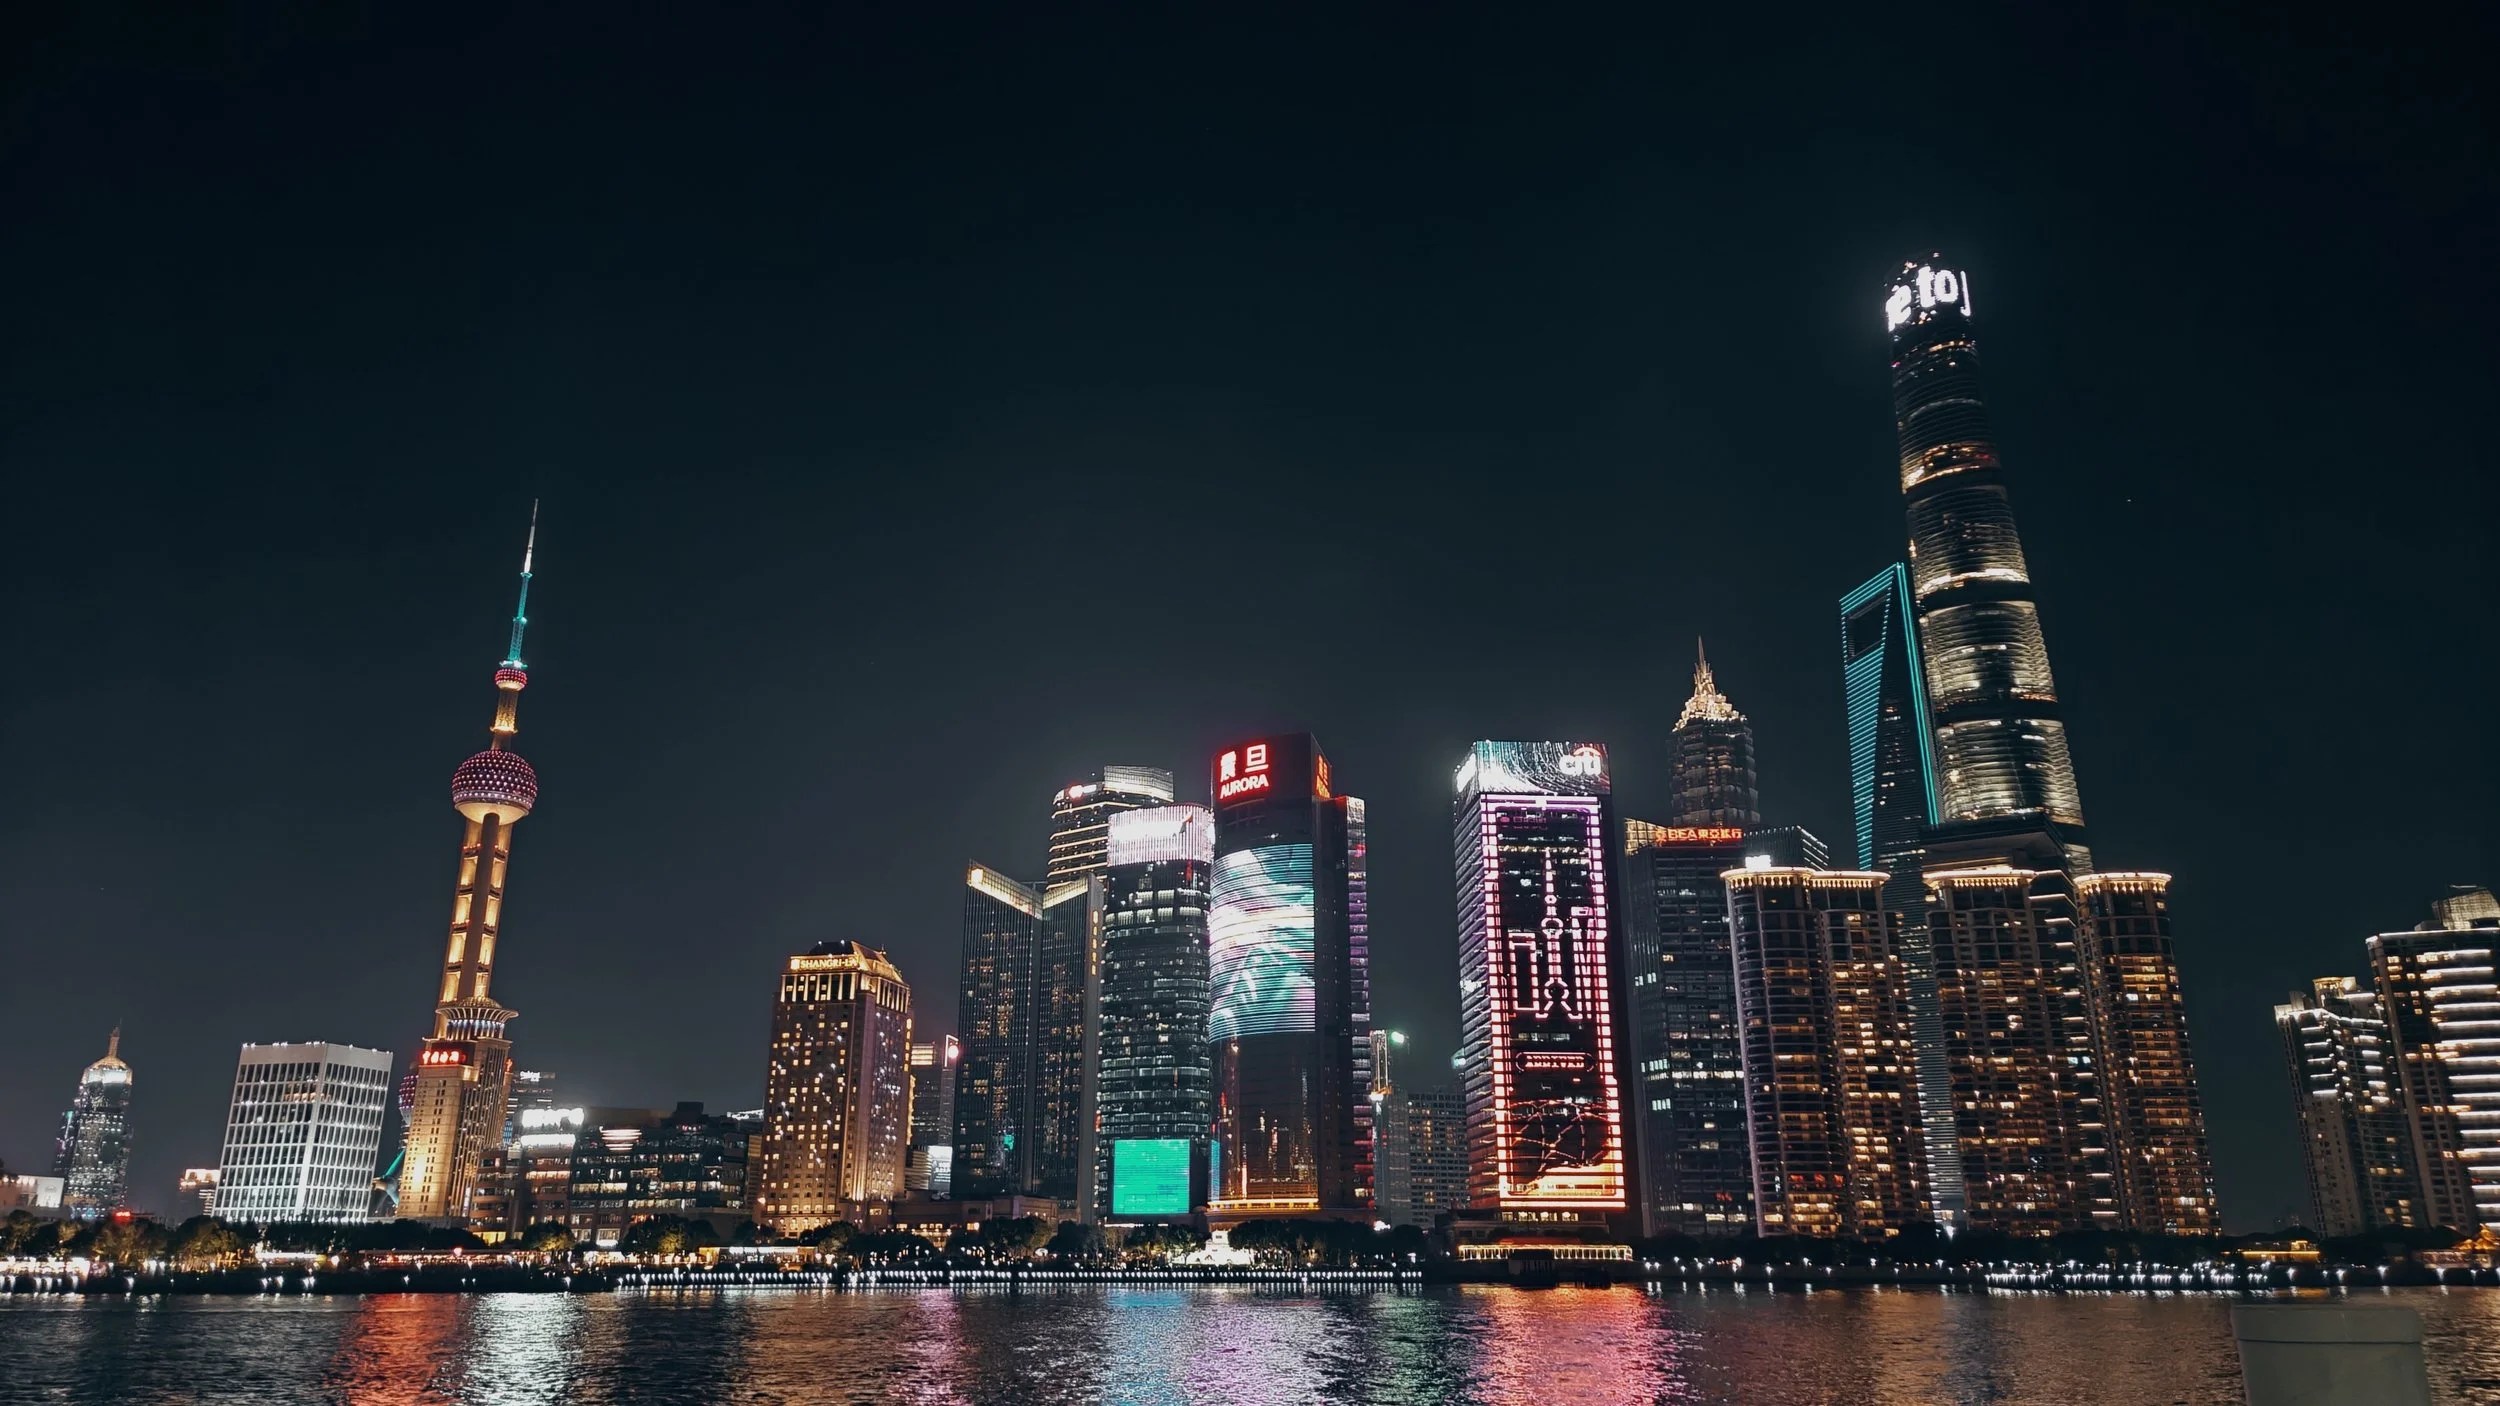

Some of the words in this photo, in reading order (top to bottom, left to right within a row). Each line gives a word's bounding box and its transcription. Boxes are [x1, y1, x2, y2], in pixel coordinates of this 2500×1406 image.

[1220, 774, 1269, 799] AURORA
[1667, 828, 1697, 839] BEA
[801, 958, 858, 969] SHANGRI-LA
